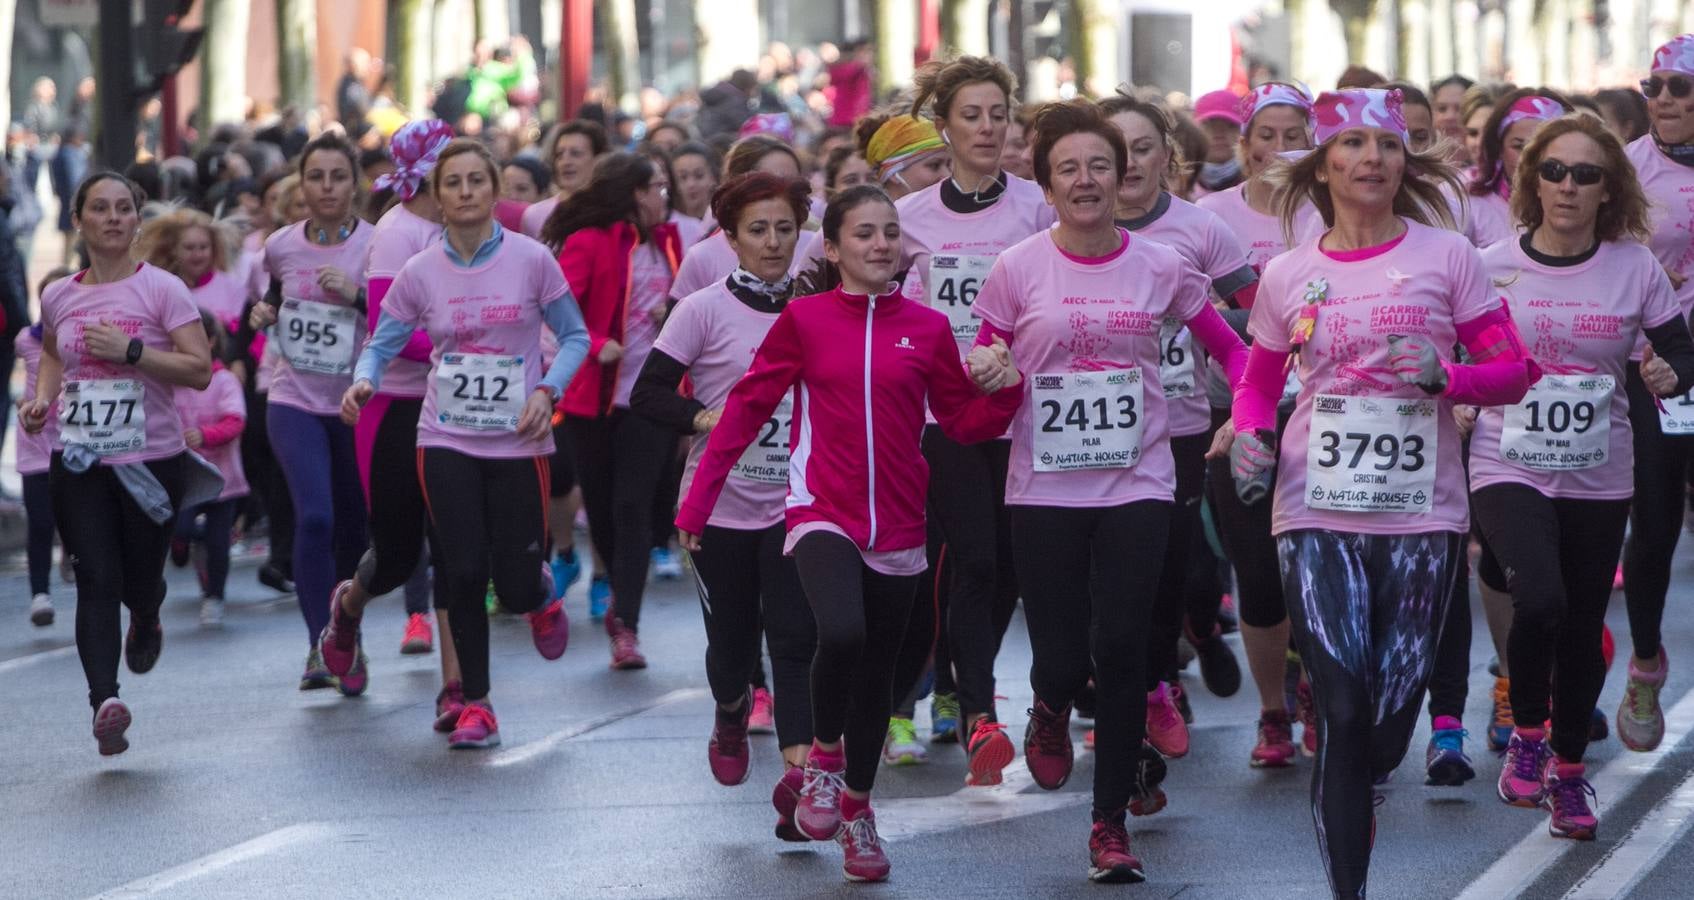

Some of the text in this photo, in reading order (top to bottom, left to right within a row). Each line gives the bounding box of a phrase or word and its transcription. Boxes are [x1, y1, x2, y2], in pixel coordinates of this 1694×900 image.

[937, 277, 987, 307] 46
[1062, 297, 1088, 305] AECC
[1528, 300, 1553, 308] AECC
[1380, 305, 1430, 316] CARRERA
[1113, 319, 1152, 329] MUJER
[1379, 314, 1426, 327] MUJER
[1580, 314, 1624, 323] CARRERA
[289, 317, 338, 347] 955
[1579, 322, 1618, 333] MUJER
[1106, 374, 1126, 383] AECC
[453, 373, 509, 402] 212
[66, 399, 136, 426] 2177
[1041, 395, 1138, 433] 2413
[1397, 404, 1418, 412] AECC
[1525, 401, 1595, 433] 109
[1082, 438, 1101, 447] PILAR
[1056, 450, 1129, 464] NATUR HOUSE
[1318, 430, 1425, 472] 3793
[1521, 451, 1593, 462] NATUR HOUSE
[742, 463, 777, 476] NATUR
[1353, 473, 1388, 484] CRISTINA
[1327, 489, 1411, 504] NATUR HOUSE
